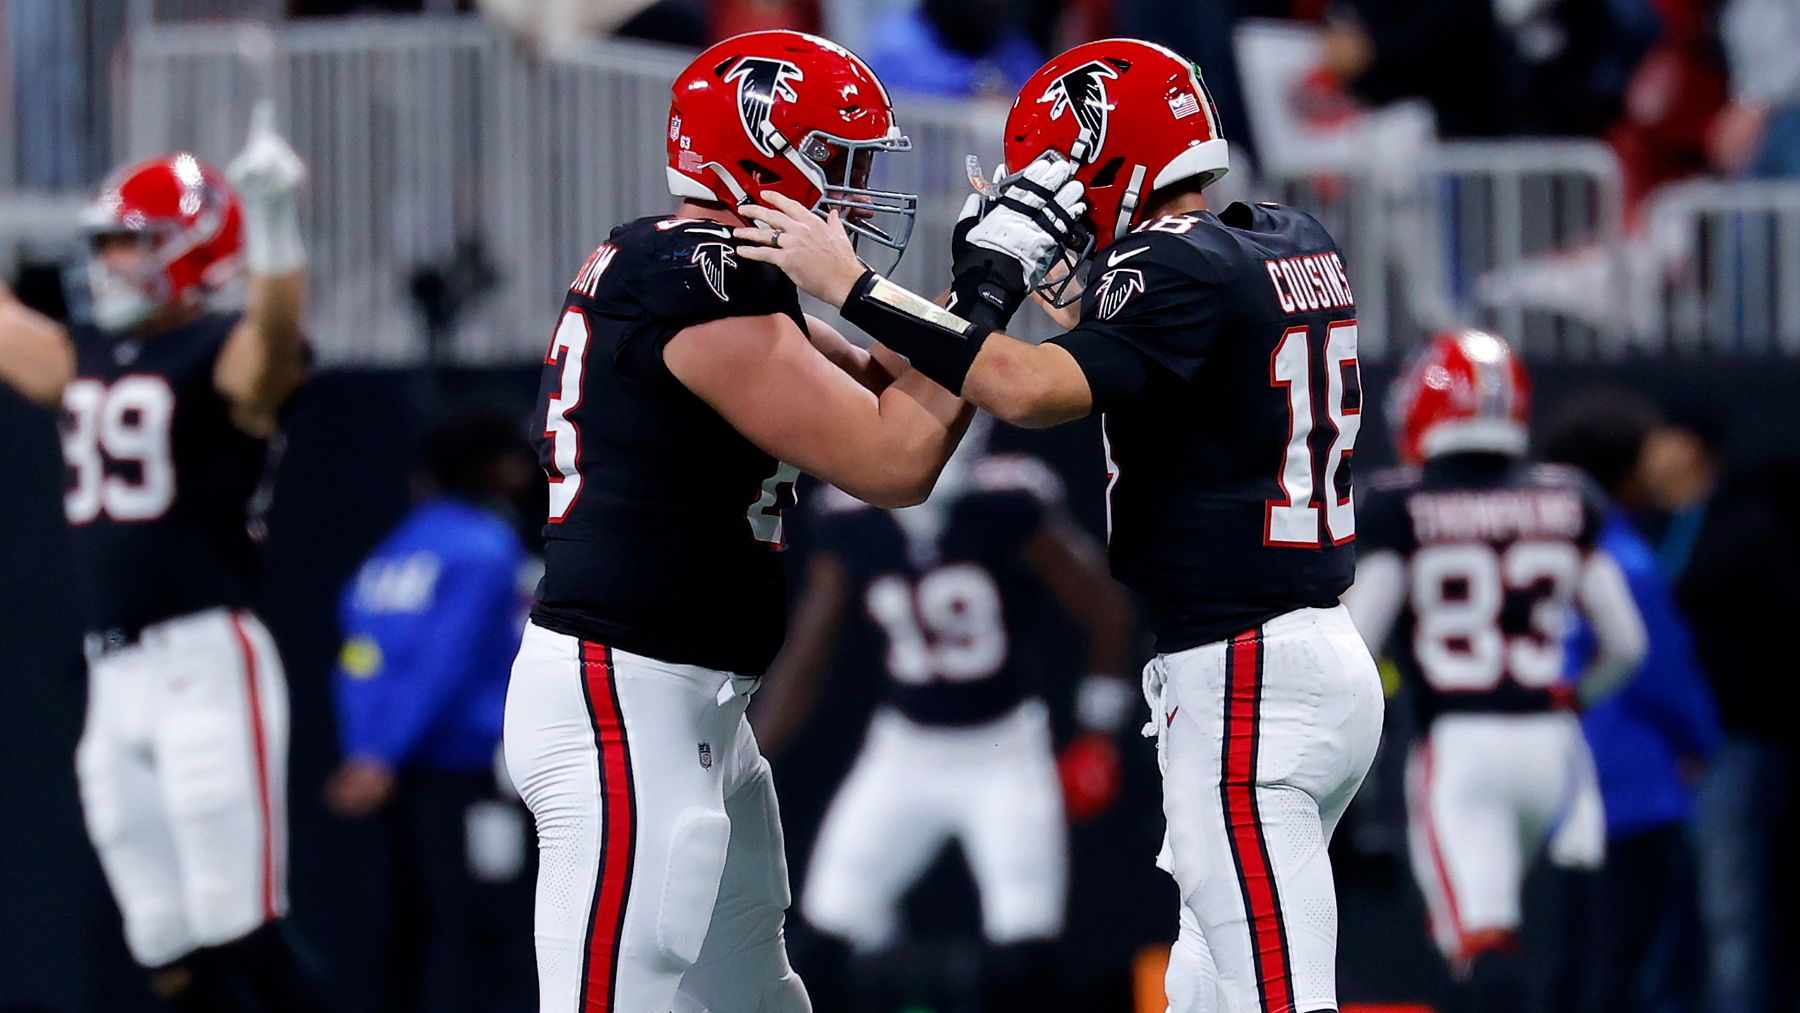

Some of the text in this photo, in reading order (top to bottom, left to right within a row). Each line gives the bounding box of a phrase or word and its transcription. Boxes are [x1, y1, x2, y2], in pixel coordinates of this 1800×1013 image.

[1265, 251, 1355, 315] COUSINS
[1263, 319, 1363, 551] 18
[863, 563, 1008, 686] 19
[1409, 540, 1582, 692] 83
